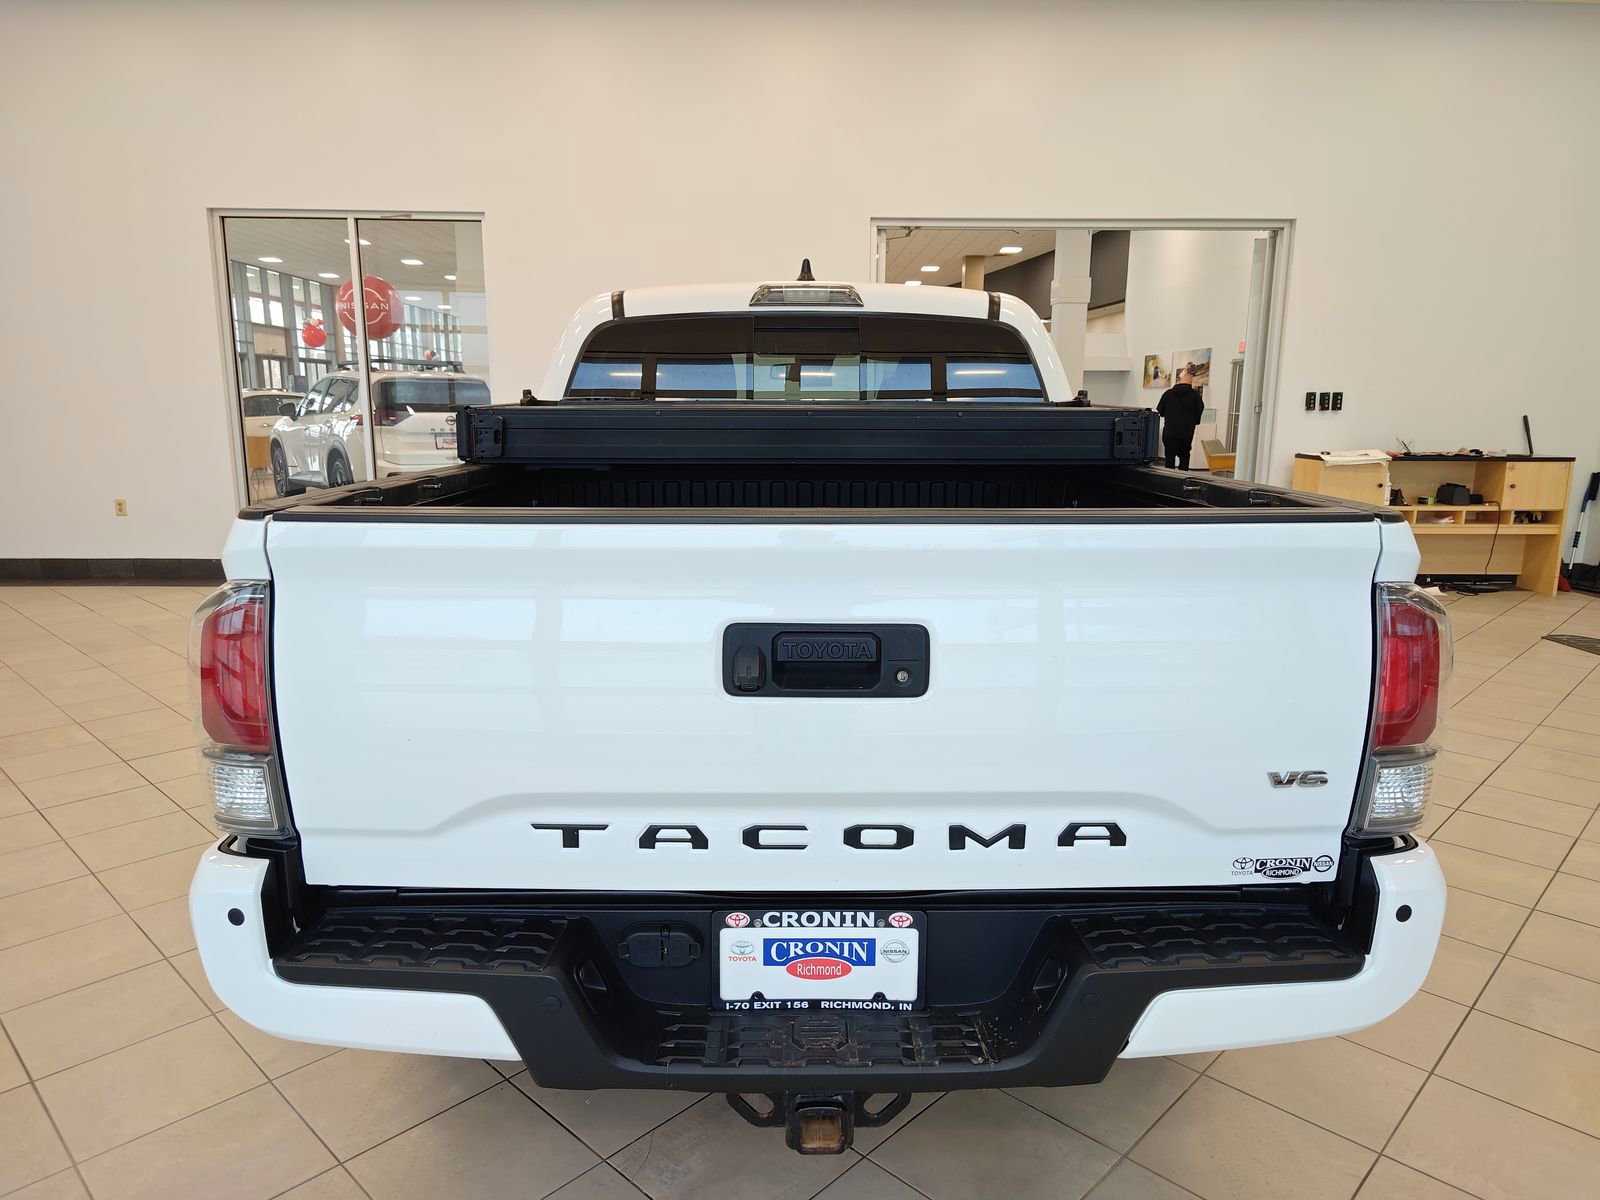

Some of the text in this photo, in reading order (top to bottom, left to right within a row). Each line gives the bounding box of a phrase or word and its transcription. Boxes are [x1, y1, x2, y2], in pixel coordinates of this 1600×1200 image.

[783, 641, 872, 659] TOYOTA
[1266, 770, 1329, 789] V6
[531, 822, 1127, 850] TACOMA
[1255, 858, 1312, 870] CRONIN
[1314, 860, 1334, 868] NISSAN
[1265, 868, 1300, 877] RICHMOND
[762, 911, 875, 928] CRONIN
[770, 941, 868, 962] CRONIN
[796, 963, 842, 976] Richmond
[725, 1001, 913, 1011] I-70 EXIT 156 RICHMOND, IN
